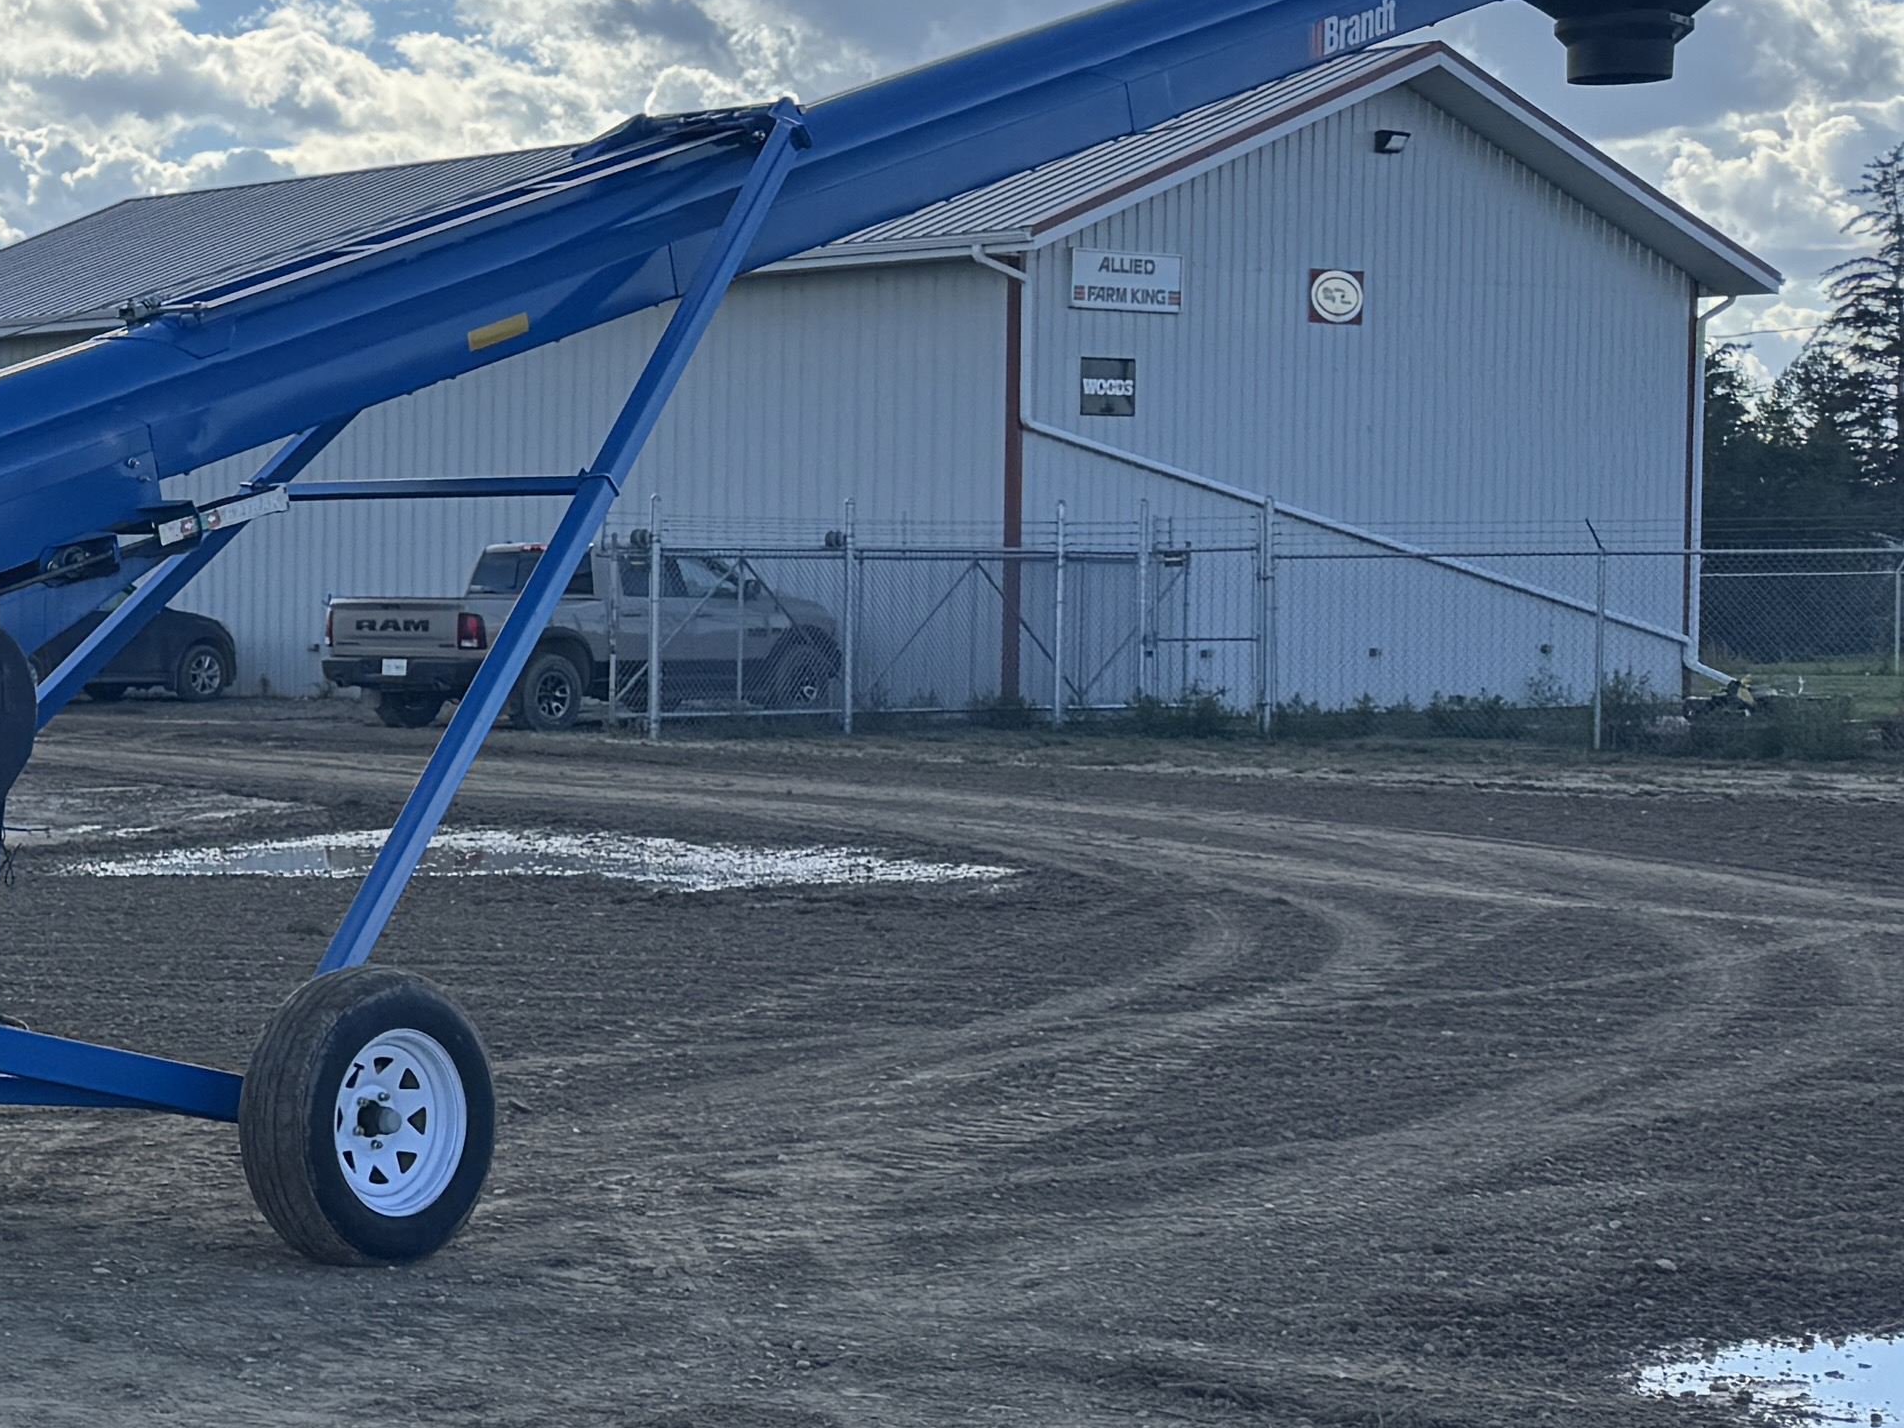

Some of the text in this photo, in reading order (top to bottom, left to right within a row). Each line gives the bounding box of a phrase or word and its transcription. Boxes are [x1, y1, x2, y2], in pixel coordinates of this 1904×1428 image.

[1098, 256, 1156, 275] ALLIED
[1087, 285, 1166, 305] FARM KING
[1083, 378, 1134, 396] WOODS
[355, 619, 430, 632] RAM
